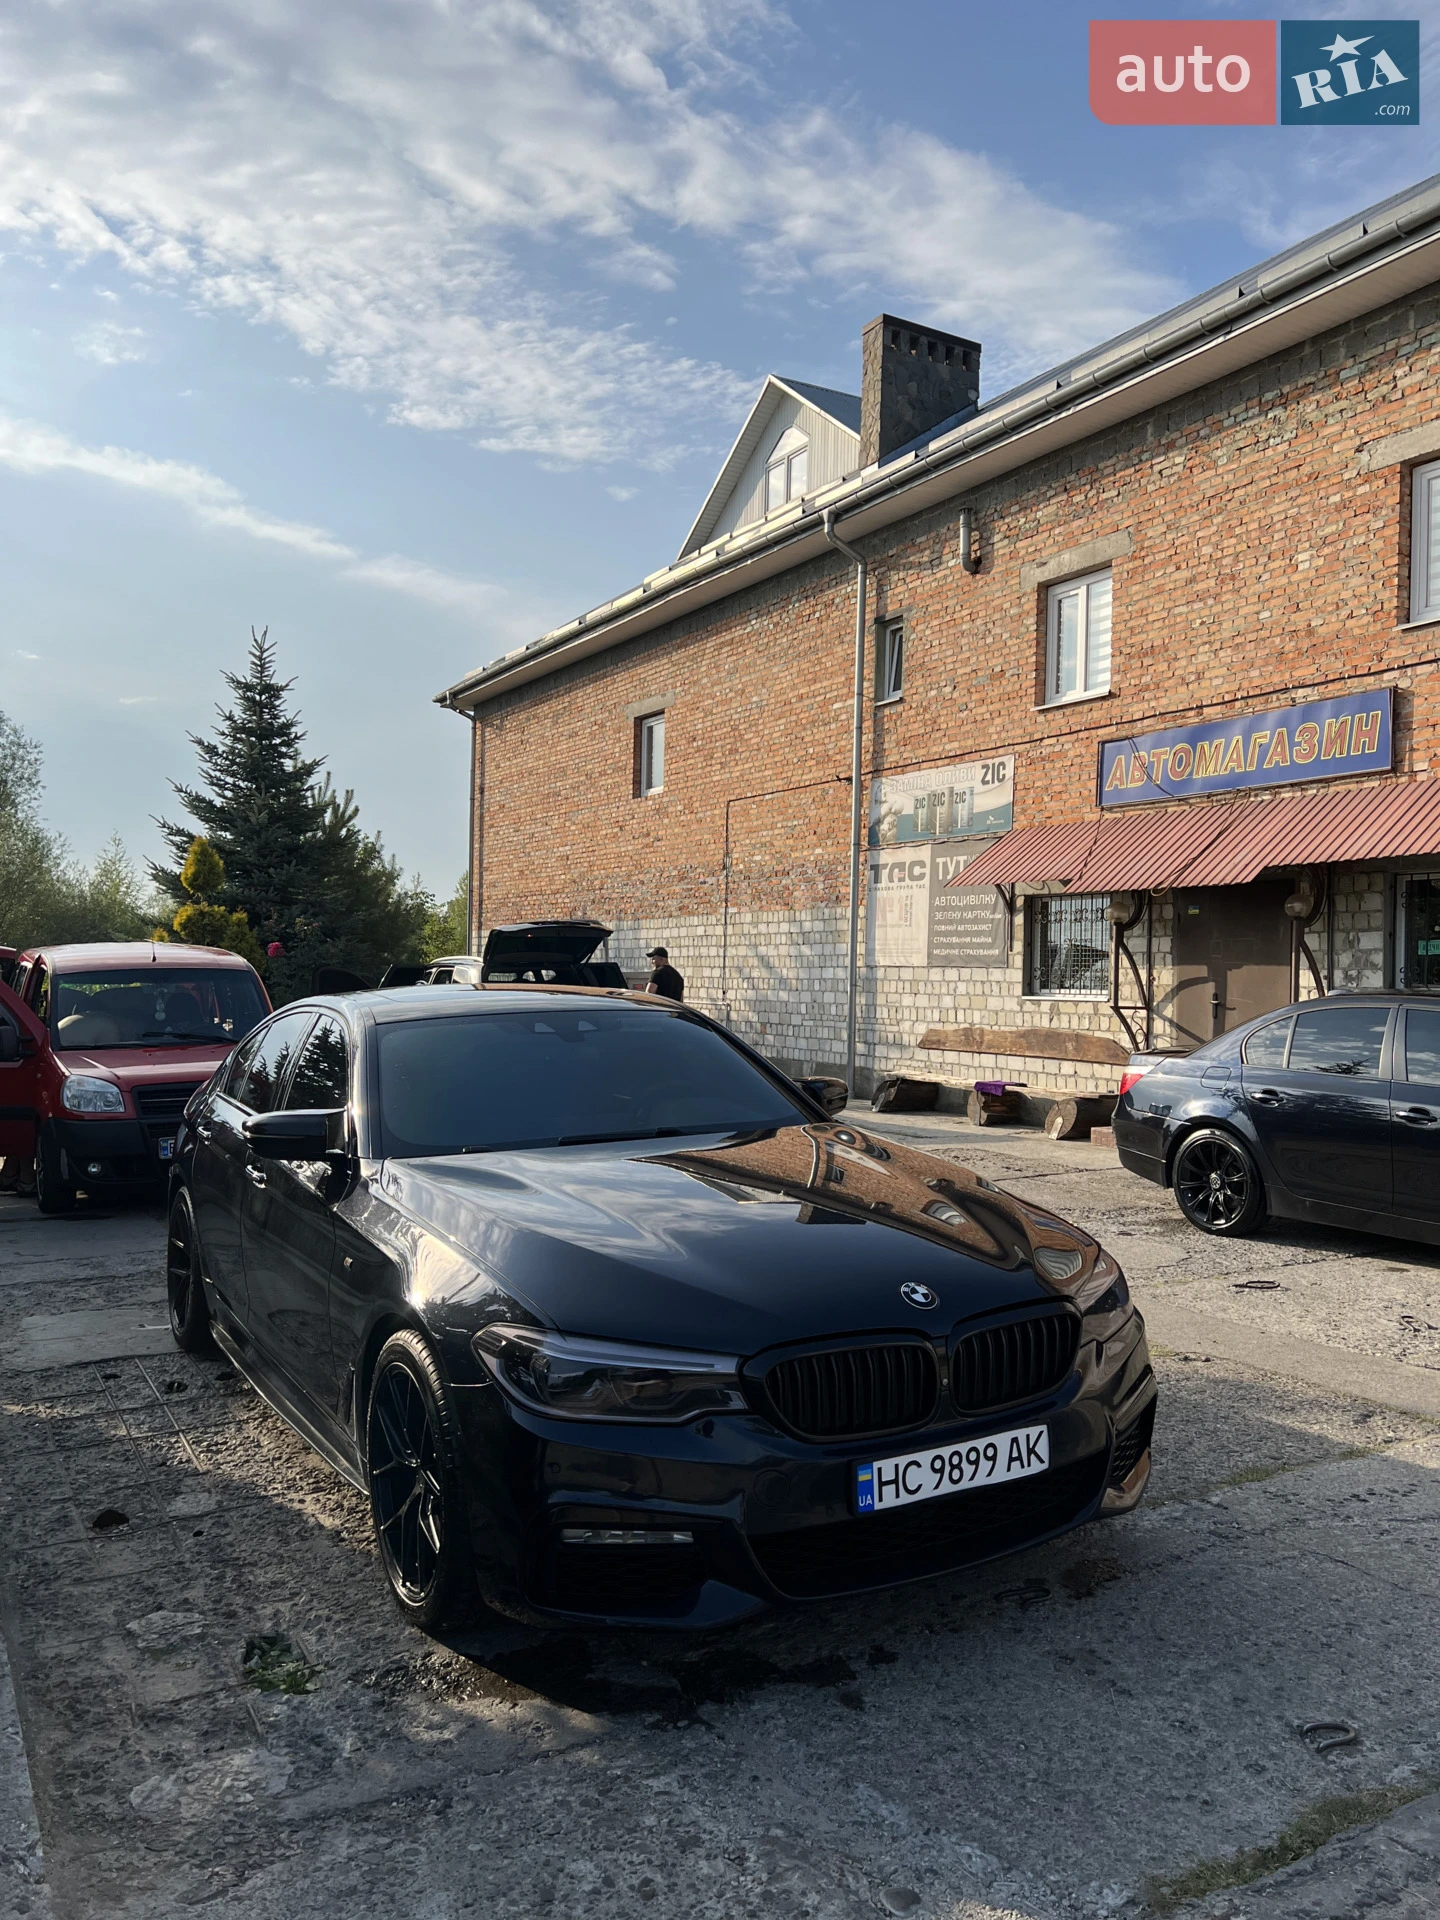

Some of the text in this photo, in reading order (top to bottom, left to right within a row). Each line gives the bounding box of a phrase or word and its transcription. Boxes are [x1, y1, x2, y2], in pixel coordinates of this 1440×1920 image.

[1105, 710, 1382, 790] АВТОМАГАЗИН
[890, 766, 976, 794] ЗАМІНА ОЛИВИ
[980, 761, 1007, 785] ZIC
[915, 797, 926, 809] ZIC
[932, 791, 946, 807] ZIC
[954, 790, 966, 804] ZIC
[936, 855, 967, 880] ТУТ
[934, 894, 996, 907] АВТОЦИВІЛКУ
[934, 911, 961, 920] ЗЕЛЕНУ
[957, 923, 992, 931] АВТОЗАХИСТ
[877, 1430, 1045, 1503] HC 9899 AK
[859, 1494, 873, 1506] UA
